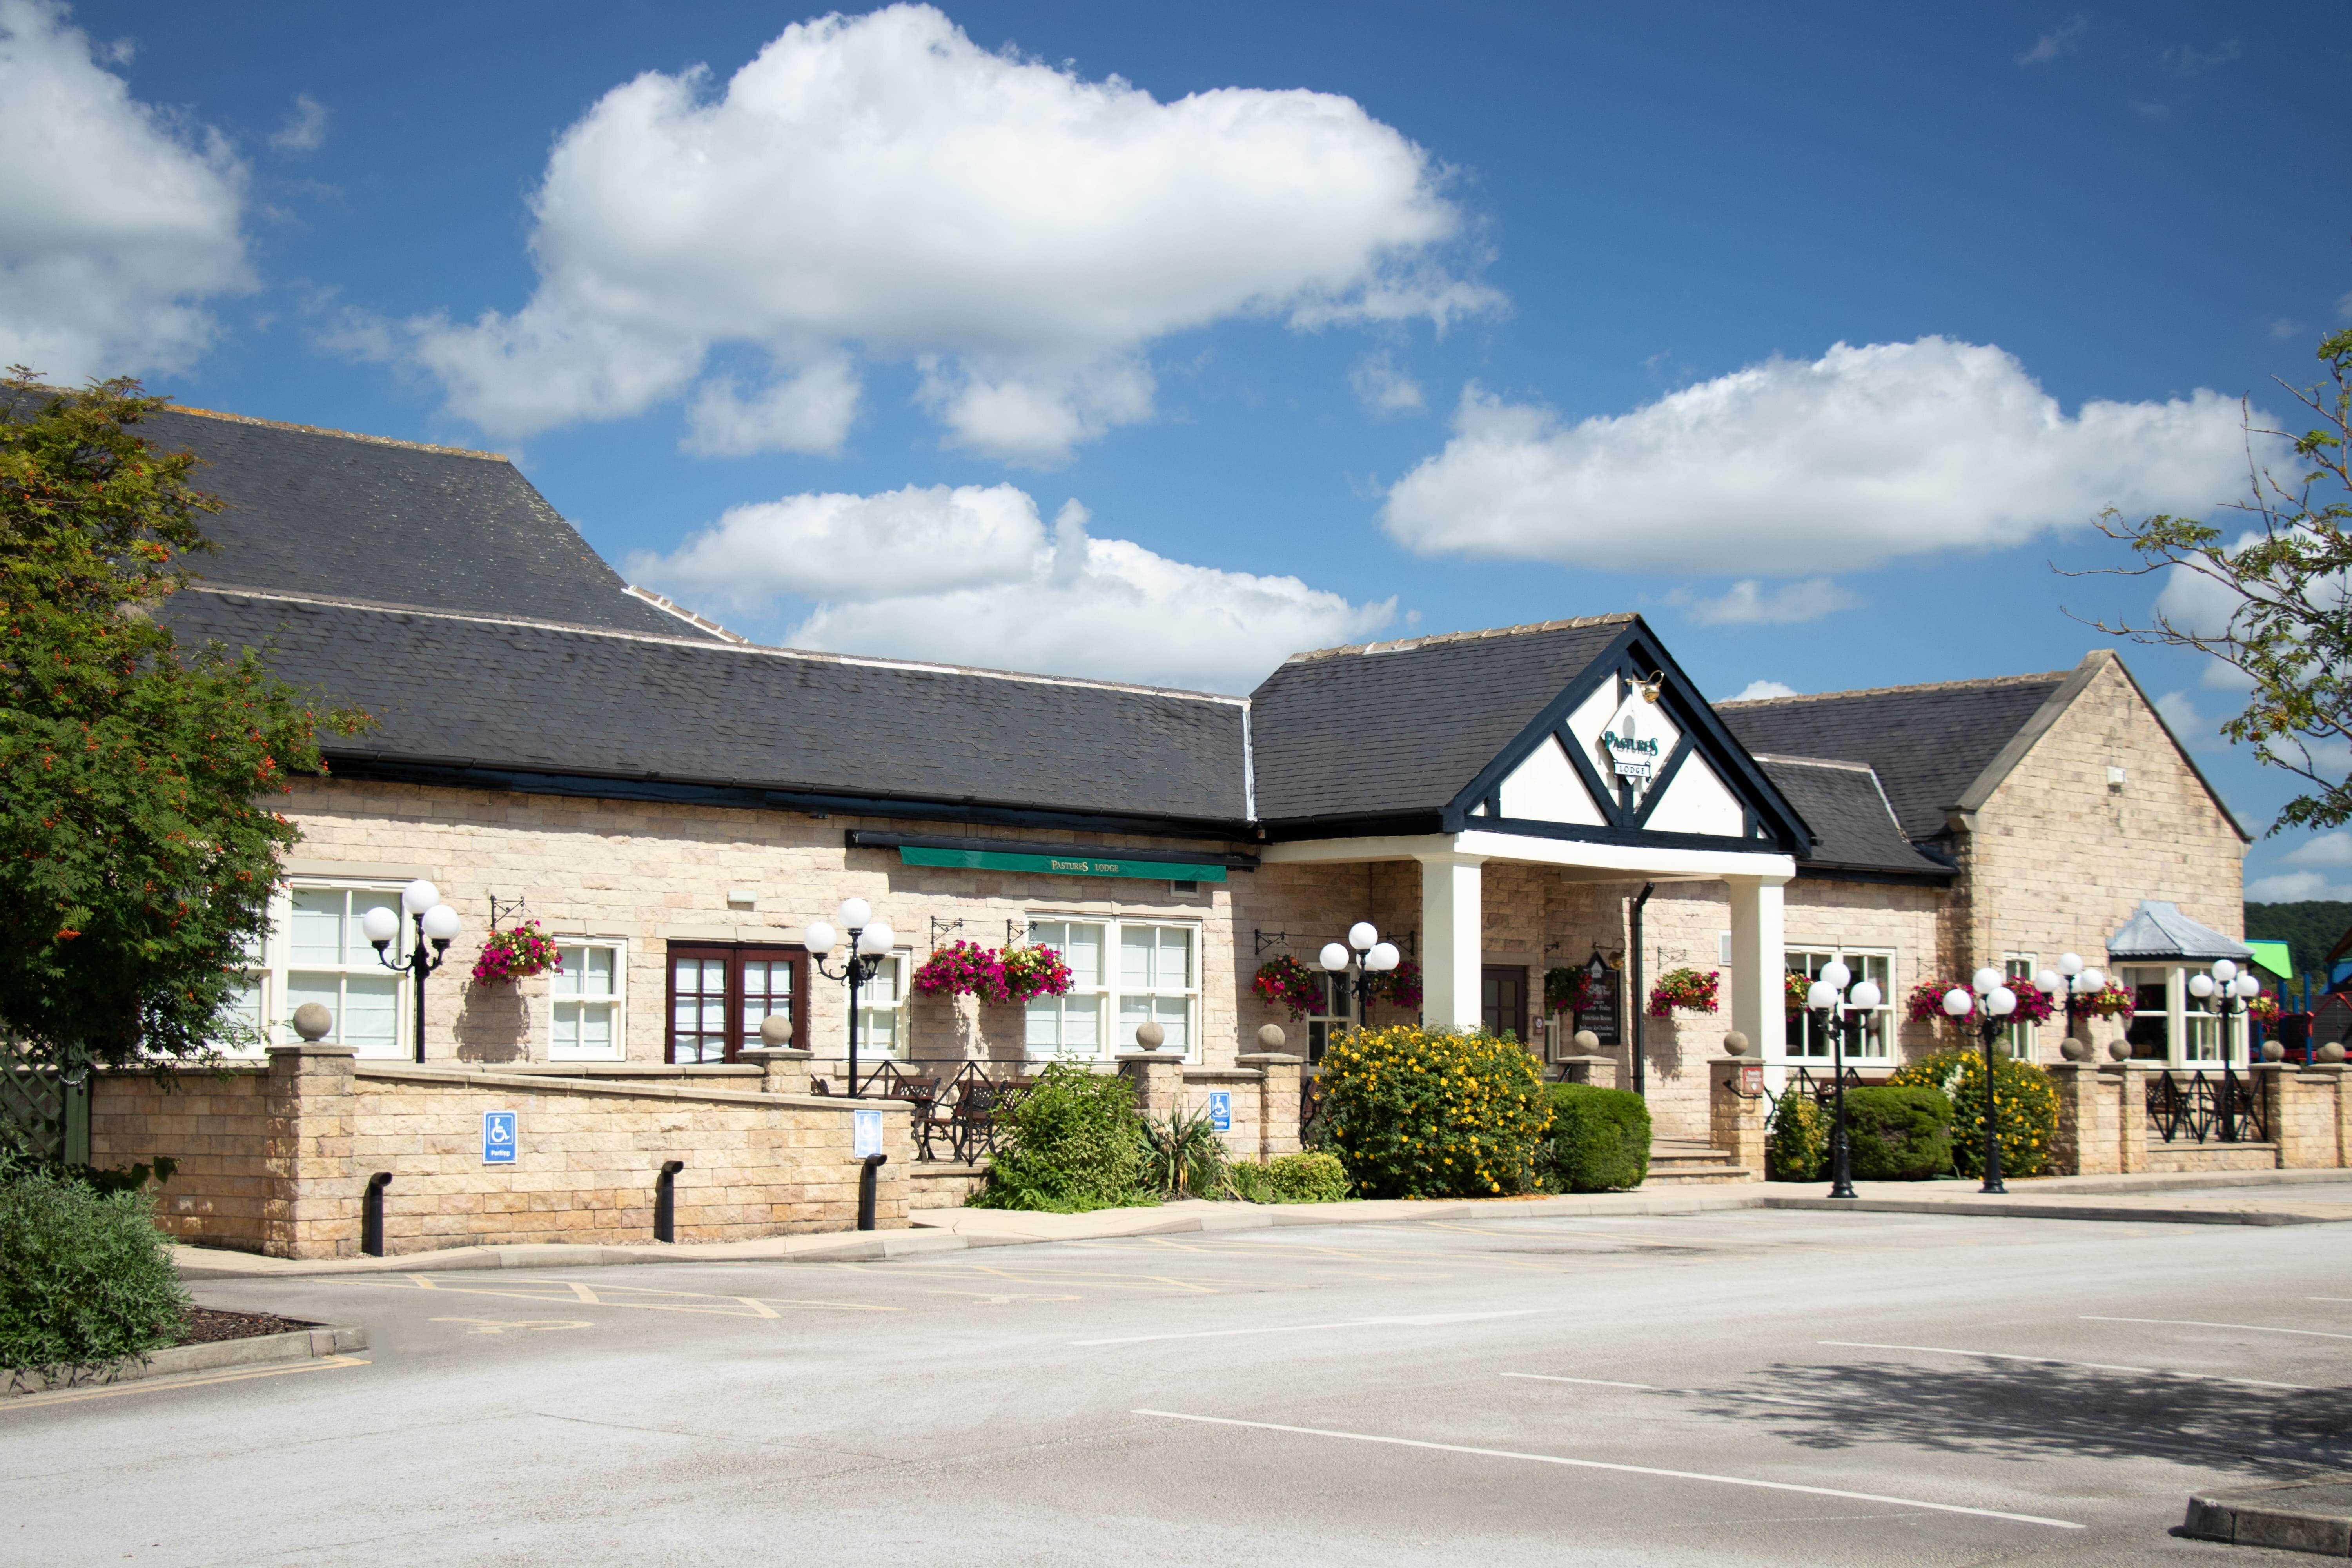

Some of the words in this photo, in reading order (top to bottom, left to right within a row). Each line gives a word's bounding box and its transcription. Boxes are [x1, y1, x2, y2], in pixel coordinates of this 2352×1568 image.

[1605, 731, 1658, 756] PASTURES
[1619, 766, 1645, 775] LODGE
[1051, 860, 1089, 872] PASTURES
[1095, 864, 1119, 872] LODGE
